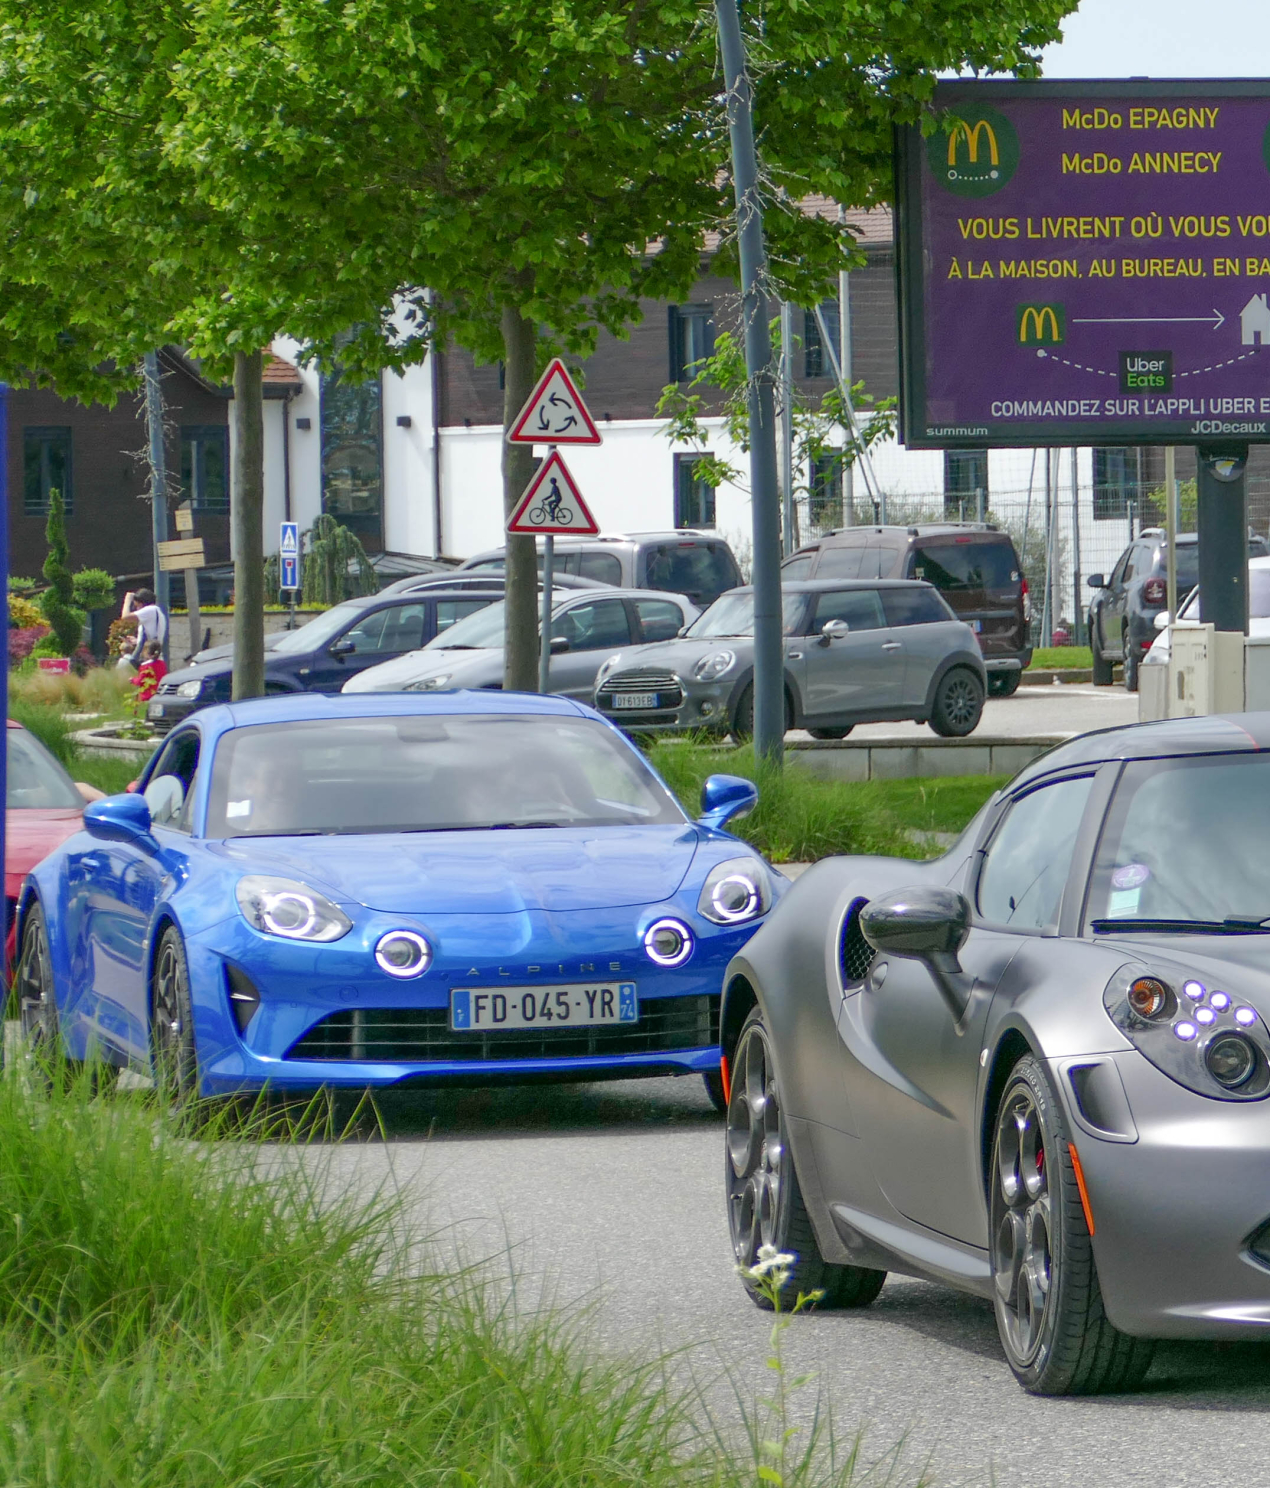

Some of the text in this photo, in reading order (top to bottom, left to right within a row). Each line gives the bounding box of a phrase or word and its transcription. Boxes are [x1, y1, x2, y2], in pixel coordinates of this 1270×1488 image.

[1062, 107, 1219, 129] McDo EPAGNY
[1061, 151, 1222, 174] McDo ANNECY
[957, 217, 1020, 239] VOUS
[1027, 217, 1124, 238] LIVRENT
[1130, 211, 1163, 238] OÙ
[1169, 216, 1231, 237] VOUS
[948, 257, 962, 279] À
[967, 260, 994, 279] LA
[999, 259, 1082, 279] MAISON,
[1088, 259, 1115, 277] AU
[1121, 259, 1207, 278] BUREAU,
[1213, 258, 1239, 276] EN
[1126, 357, 1165, 372] Uber
[1127, 373, 1165, 387] Eats
[991, 400, 1100, 417] COMMANDEZ
[1104, 399, 1139, 416] SUR
[1144, 398, 1205, 415] L'APPLI
[1209, 398, 1255, 414] UBER
[926, 428, 988, 436] summum
[1191, 420, 1266, 434] JCDecaux
[466, 962, 621, 976] ALPINE
[474, 989, 614, 1023] FD-045-YR
